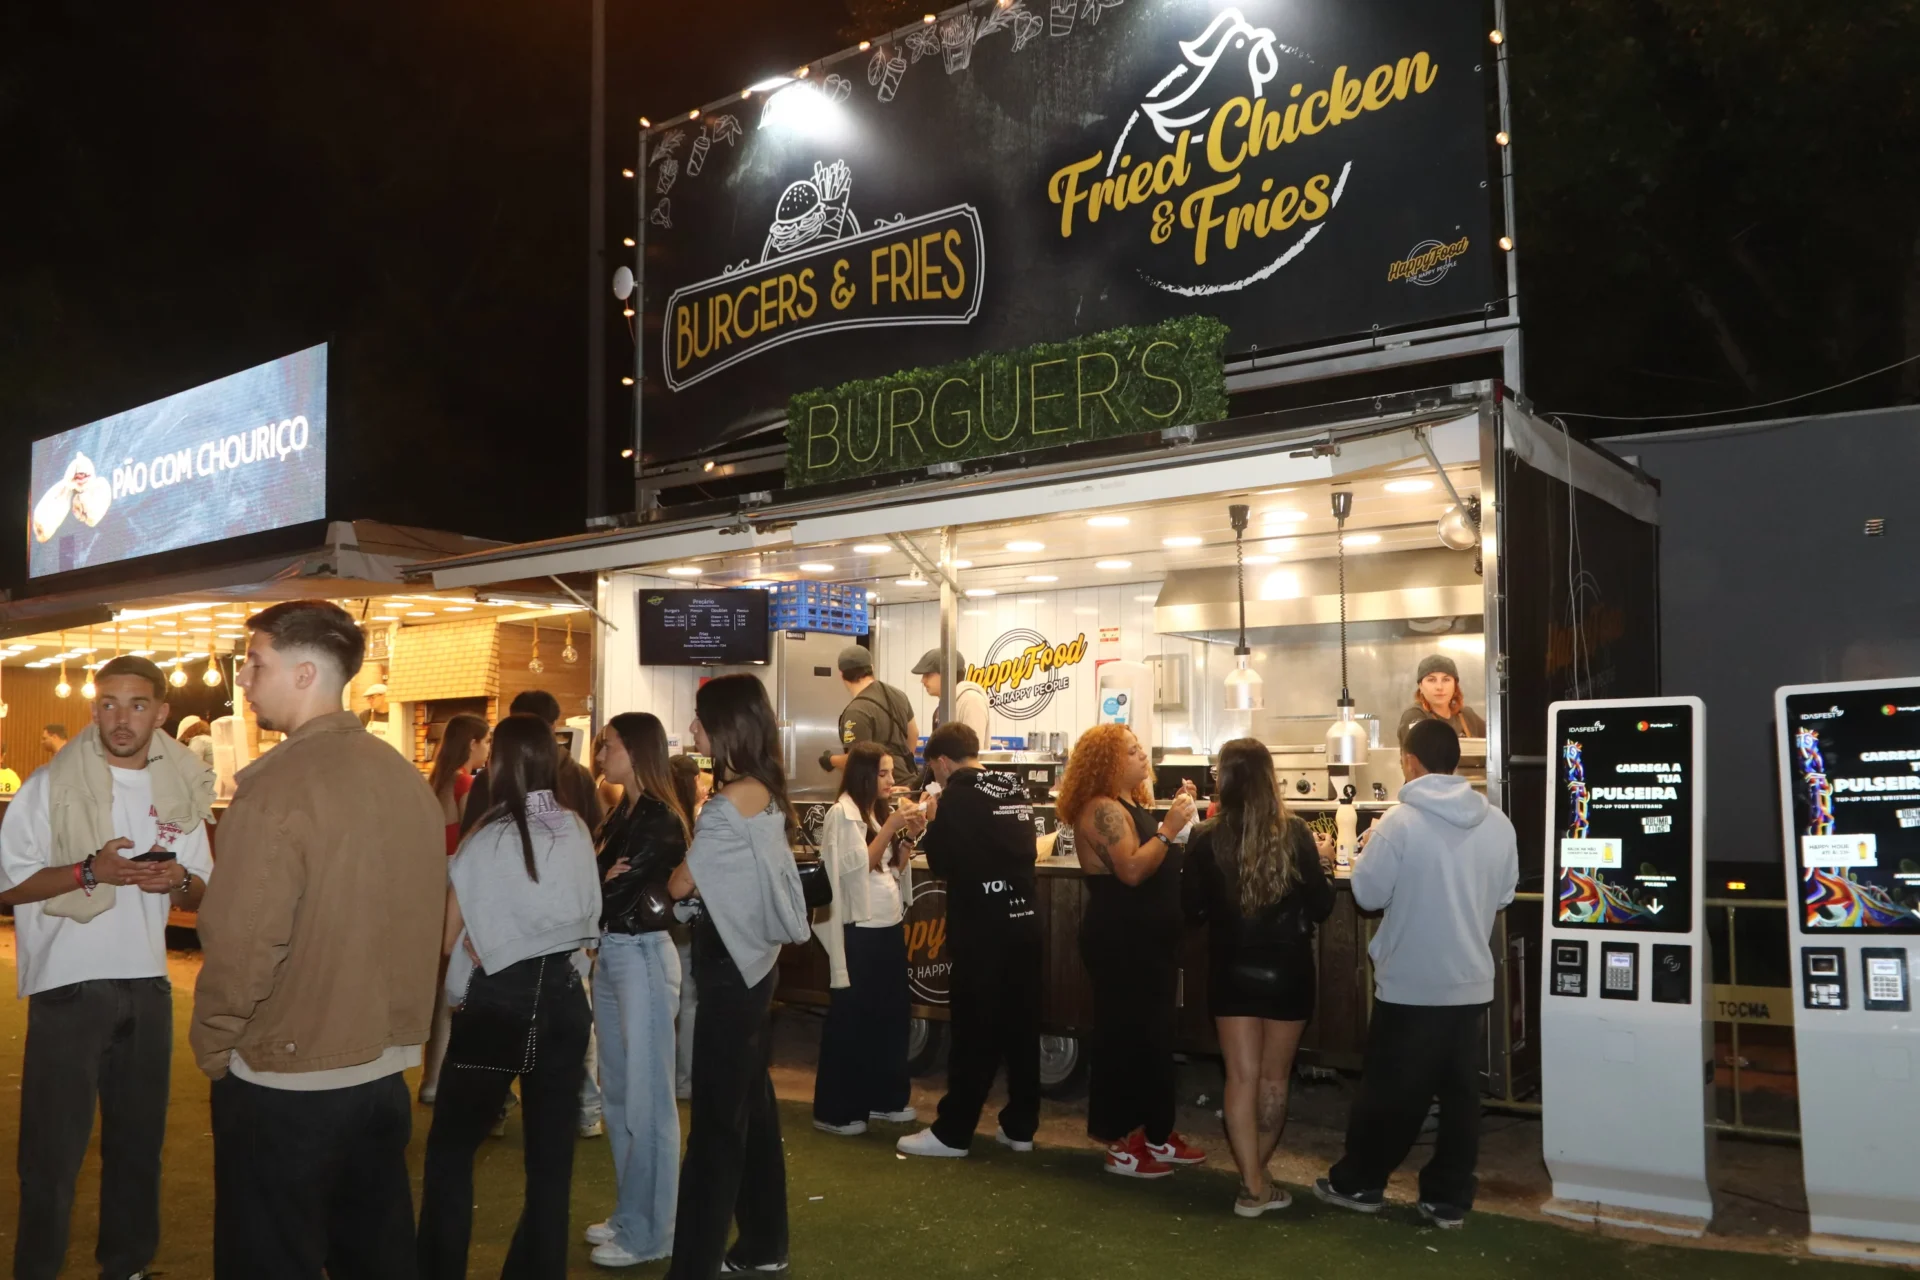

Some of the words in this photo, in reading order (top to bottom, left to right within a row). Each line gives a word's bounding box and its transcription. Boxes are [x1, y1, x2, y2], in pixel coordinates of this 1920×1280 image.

[1048, 130, 1192, 238] Fried
[1205, 51, 1439, 173] Chicken
[1150, 200, 1176, 244] &
[1180, 172, 1330, 266] Fries
[1387, 236, 1469, 282] HappyFood
[1405, 275, 1418, 284] FOR
[1418, 268, 1436, 279] HAPPY
[1436, 260, 1457, 273] PEOPLE
[676, 267, 818, 370] BURGERS
[830, 259, 856, 311] &
[871, 229, 966, 306] FRIES
[807, 340, 1183, 470] BURGUER'S
[112, 457, 148, 500] PÃO
[150, 447, 192, 490] COM
[196, 415, 309, 477] CHOURIÇO
[989, 695, 1003, 708] OR
[1003, 686, 1032, 704] HAPPY
[1034, 676, 1070, 697] PEOPLE
[1615, 763, 1670, 773] CARREGA
[1671, 763, 1682, 773] A
[1656, 773, 1682, 784] TUA
[1592, 786, 1678, 800] PULSEIRA
[917, 962, 953, 979] HAPPY
